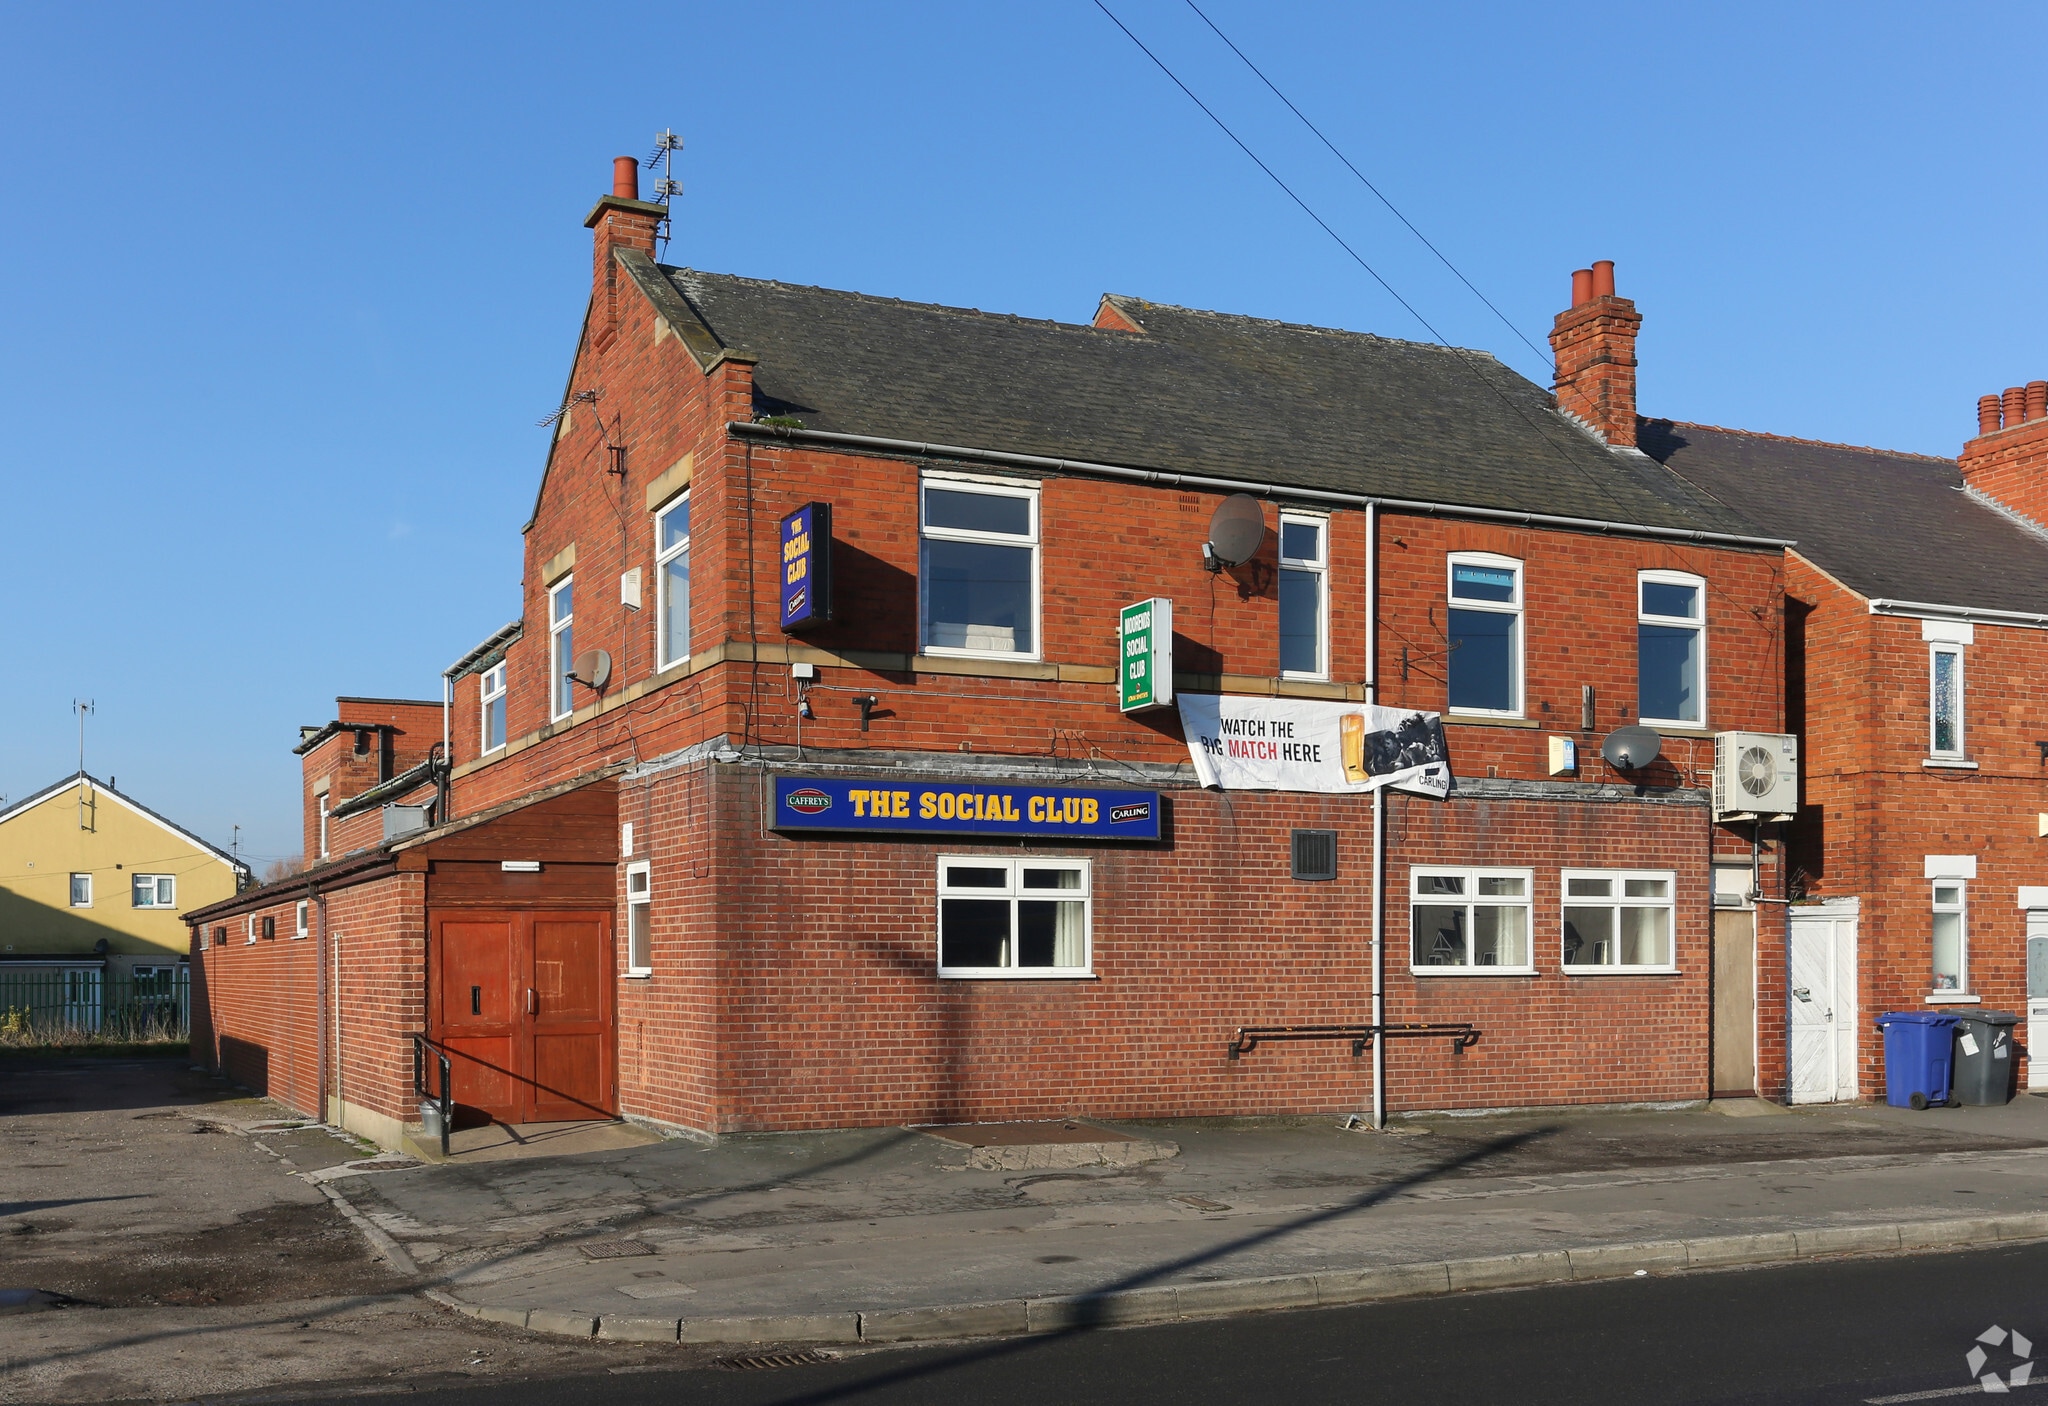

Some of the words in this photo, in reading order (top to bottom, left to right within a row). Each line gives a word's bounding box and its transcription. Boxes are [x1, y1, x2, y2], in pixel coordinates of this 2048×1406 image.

[791, 517, 802, 536] THE
[784, 532, 810, 563] SOCIAL
[787, 557, 806, 585] CLUB
[1125, 610, 1151, 635] MOORENDS
[1126, 636, 1148, 658] SOCIAL
[1129, 659, 1146, 680] CLUB
[1221, 718, 1266, 737] WATCH
[1270, 721, 1294, 738] THE
[1201, 735, 1223, 756] BIG
[1228, 739, 1277, 760] MATCH
[1283, 743, 1321, 763] HERE
[789, 796, 829, 806] CAFFREY'S
[849, 789, 910, 819] THE
[919, 791, 1020, 822] SOCIAL
[1028, 796, 1099, 824] CLUB
[1112, 807, 1148, 820] CARLING
